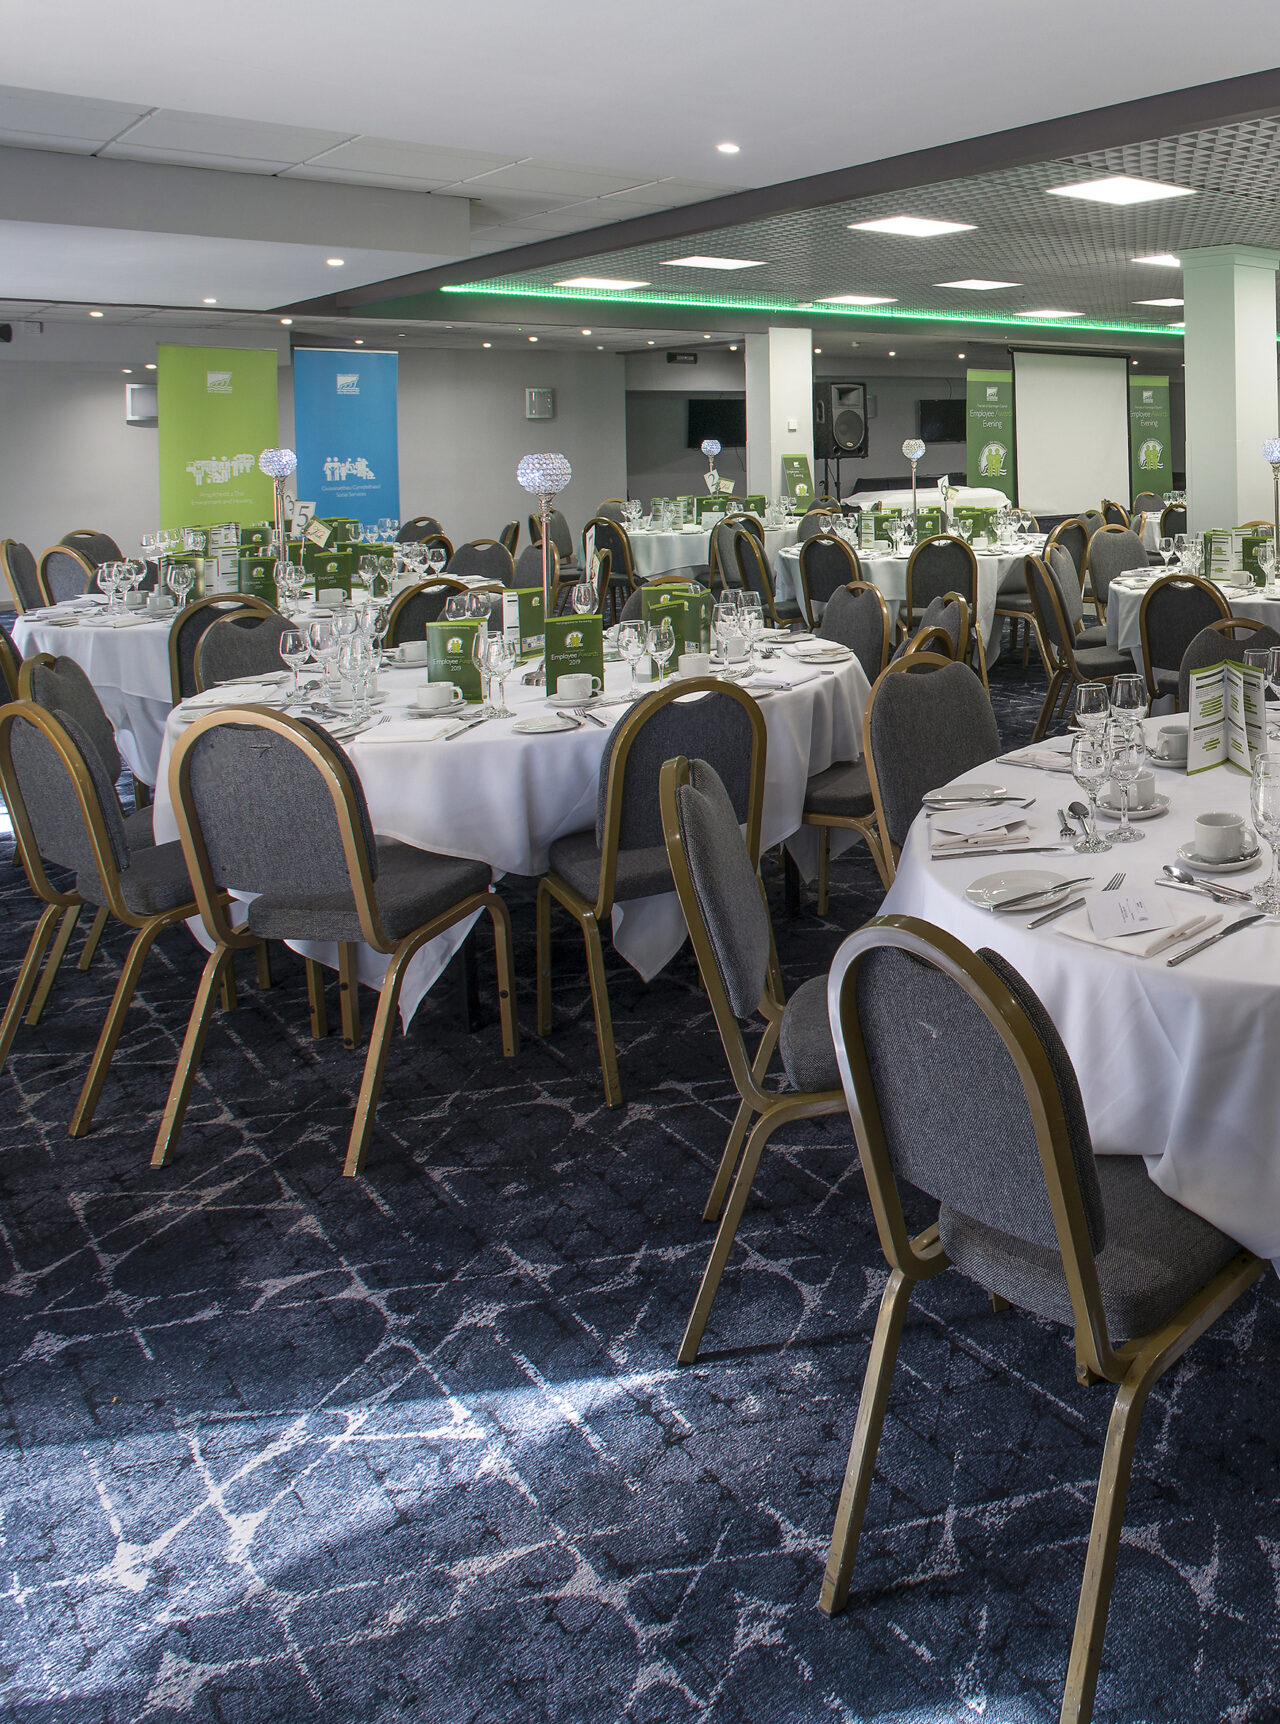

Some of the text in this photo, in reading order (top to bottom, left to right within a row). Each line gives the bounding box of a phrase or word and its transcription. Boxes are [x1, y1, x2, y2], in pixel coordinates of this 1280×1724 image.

[970, 410, 995, 418] Employee
[983, 420, 1003, 429] Evening
[1141, 420, 1158, 428] Evening
[708, 474, 717, 487] 2
[297, 505, 310, 527] 5
[551, 653, 578, 662] Employee
